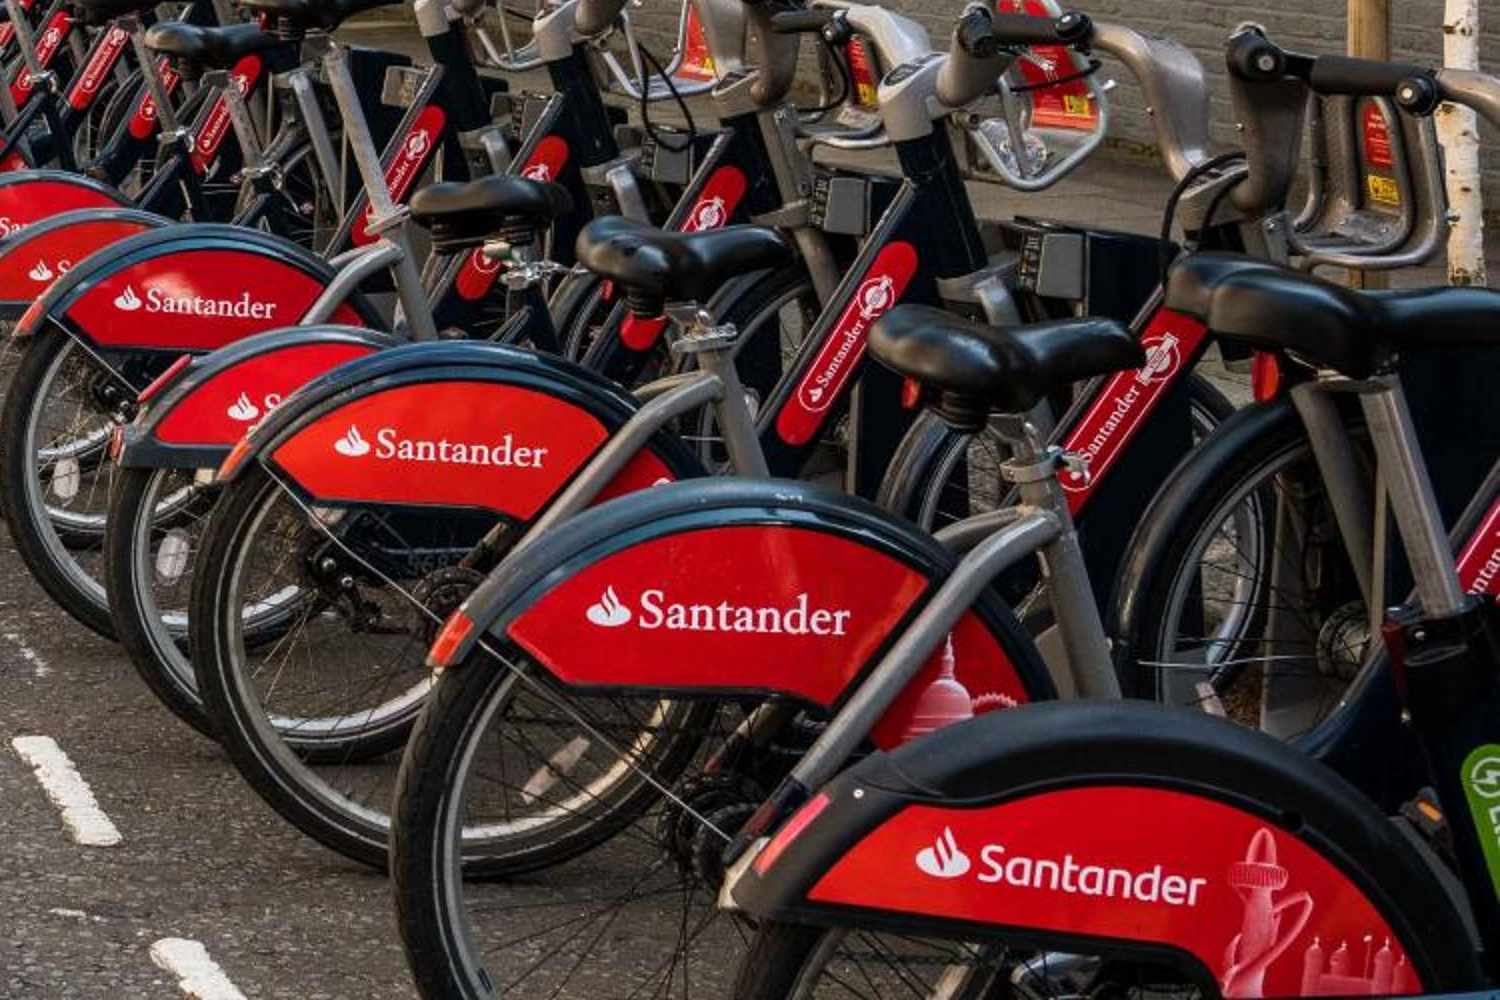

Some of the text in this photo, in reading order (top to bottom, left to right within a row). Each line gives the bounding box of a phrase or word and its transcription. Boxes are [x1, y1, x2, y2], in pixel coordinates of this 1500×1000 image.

[145, 287, 277, 319] Santander
[816, 321, 866, 388] Santander
[375, 427, 548, 469] Santander
[1077, 385, 1141, 463] Santander
[639, 589, 850, 635] Santander
[977, 844, 1207, 906] Santander
